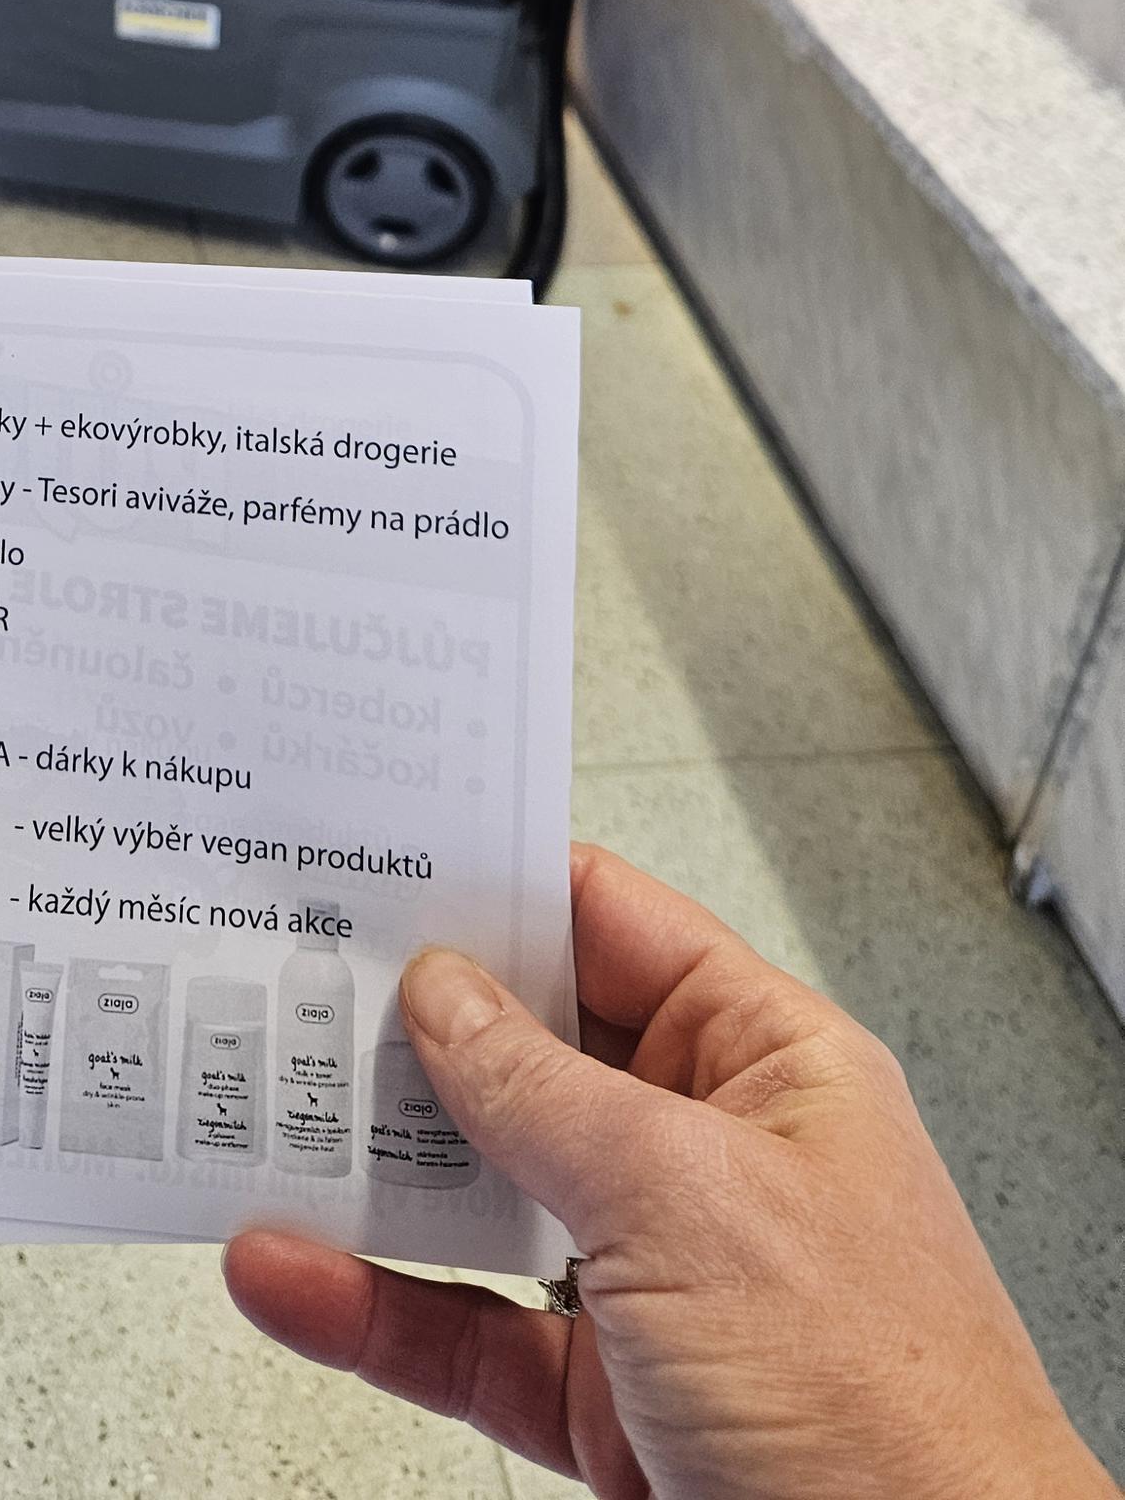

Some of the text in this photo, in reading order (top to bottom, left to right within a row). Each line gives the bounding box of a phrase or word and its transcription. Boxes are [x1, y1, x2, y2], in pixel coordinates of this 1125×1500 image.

[34, 416, 53, 436] +
[60, 412, 227, 456] ekovýrobky,
[236, 425, 324, 457] italská
[333, 432, 457, 470] drogerie
[37, 476, 118, 508] Tesori
[125, 486, 234, 521] aviváže,
[243, 496, 362, 535] parfémy
[370, 510, 404, 532] na
[414, 509, 509, 540] prádlo
[36, 743, 114, 782] dárky
[122, 750, 137, 778] k
[145, 755, 251, 793] nákupu
[32, 814, 106, 852] velký
[112, 821, 194, 855] výběr
[200, 834, 287, 865] vegan
[297, 845, 432, 880] produktů
[28, 883, 111, 925] každý
[119, 893, 201, 925] měsíc
[209, 903, 278, 931] nová
[287, 906, 353, 939] akce
